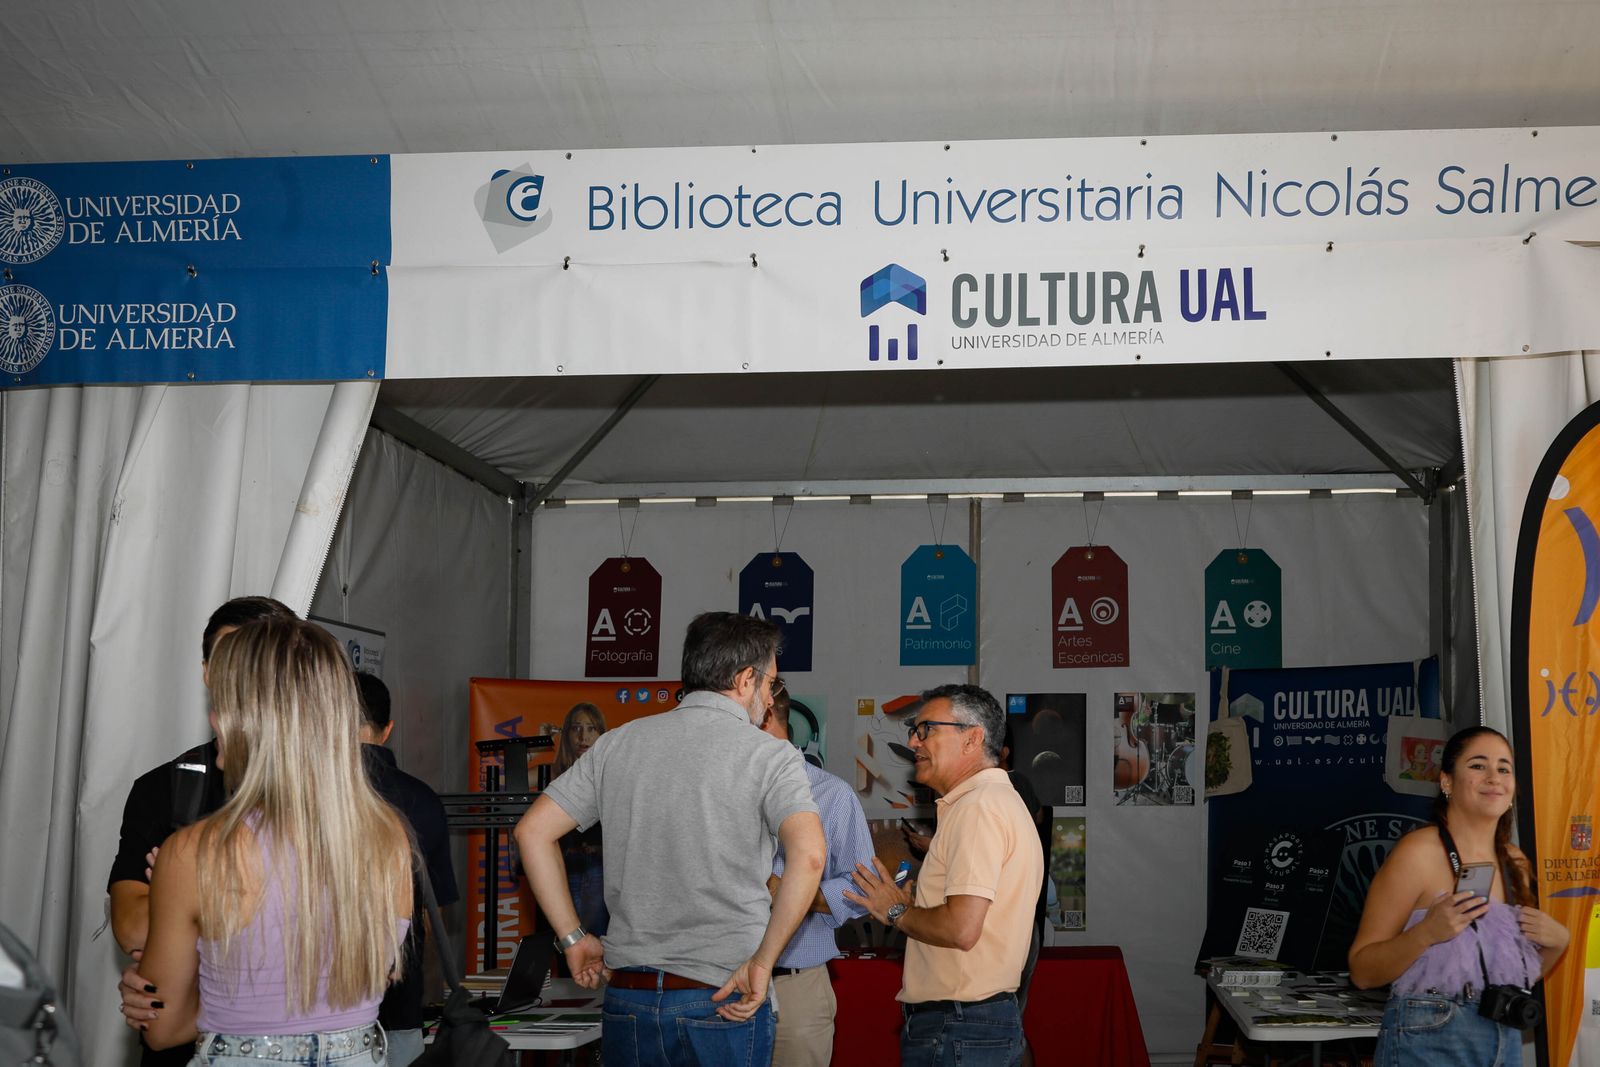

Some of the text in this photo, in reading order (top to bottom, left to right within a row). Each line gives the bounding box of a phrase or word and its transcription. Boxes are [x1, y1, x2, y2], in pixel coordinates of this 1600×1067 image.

[21, 179, 59, 211] SAPIENTIA
[65, 193, 241, 218] UNIVERSIDAD
[588, 163, 1599, 231] Biblioteca Universitaria Nicolás Salme
[21, 215, 63, 263] ALMERIENSIS
[68, 214, 242, 244] DE ALMERÍA
[16, 286, 52, 317] SAPIENTIA
[951, 267, 1267, 329] CULTURA UAL
[59, 302, 238, 324] UNIVERSIDAD
[21, 322, 54, 371] ALMERIENSIS
[58, 322, 237, 351] DE ALMERÍA
[951, 328, 1164, 350] UNIVERSIDAD DE ALMERÍA
[905, 637, 972, 650] Patrimonio
[1057, 635, 1093, 647] Artes
[1210, 642, 1241, 655] Cine
[1273, 686, 1418, 720] CULTURA UAL
[1273, 719, 1371, 730] UNIVERSIDAD DE ALMERÍA
[1309, 867, 1323, 875] Paso
[1546, 871, 1563, 881] DE
[1265, 882, 1279, 890] Paso
